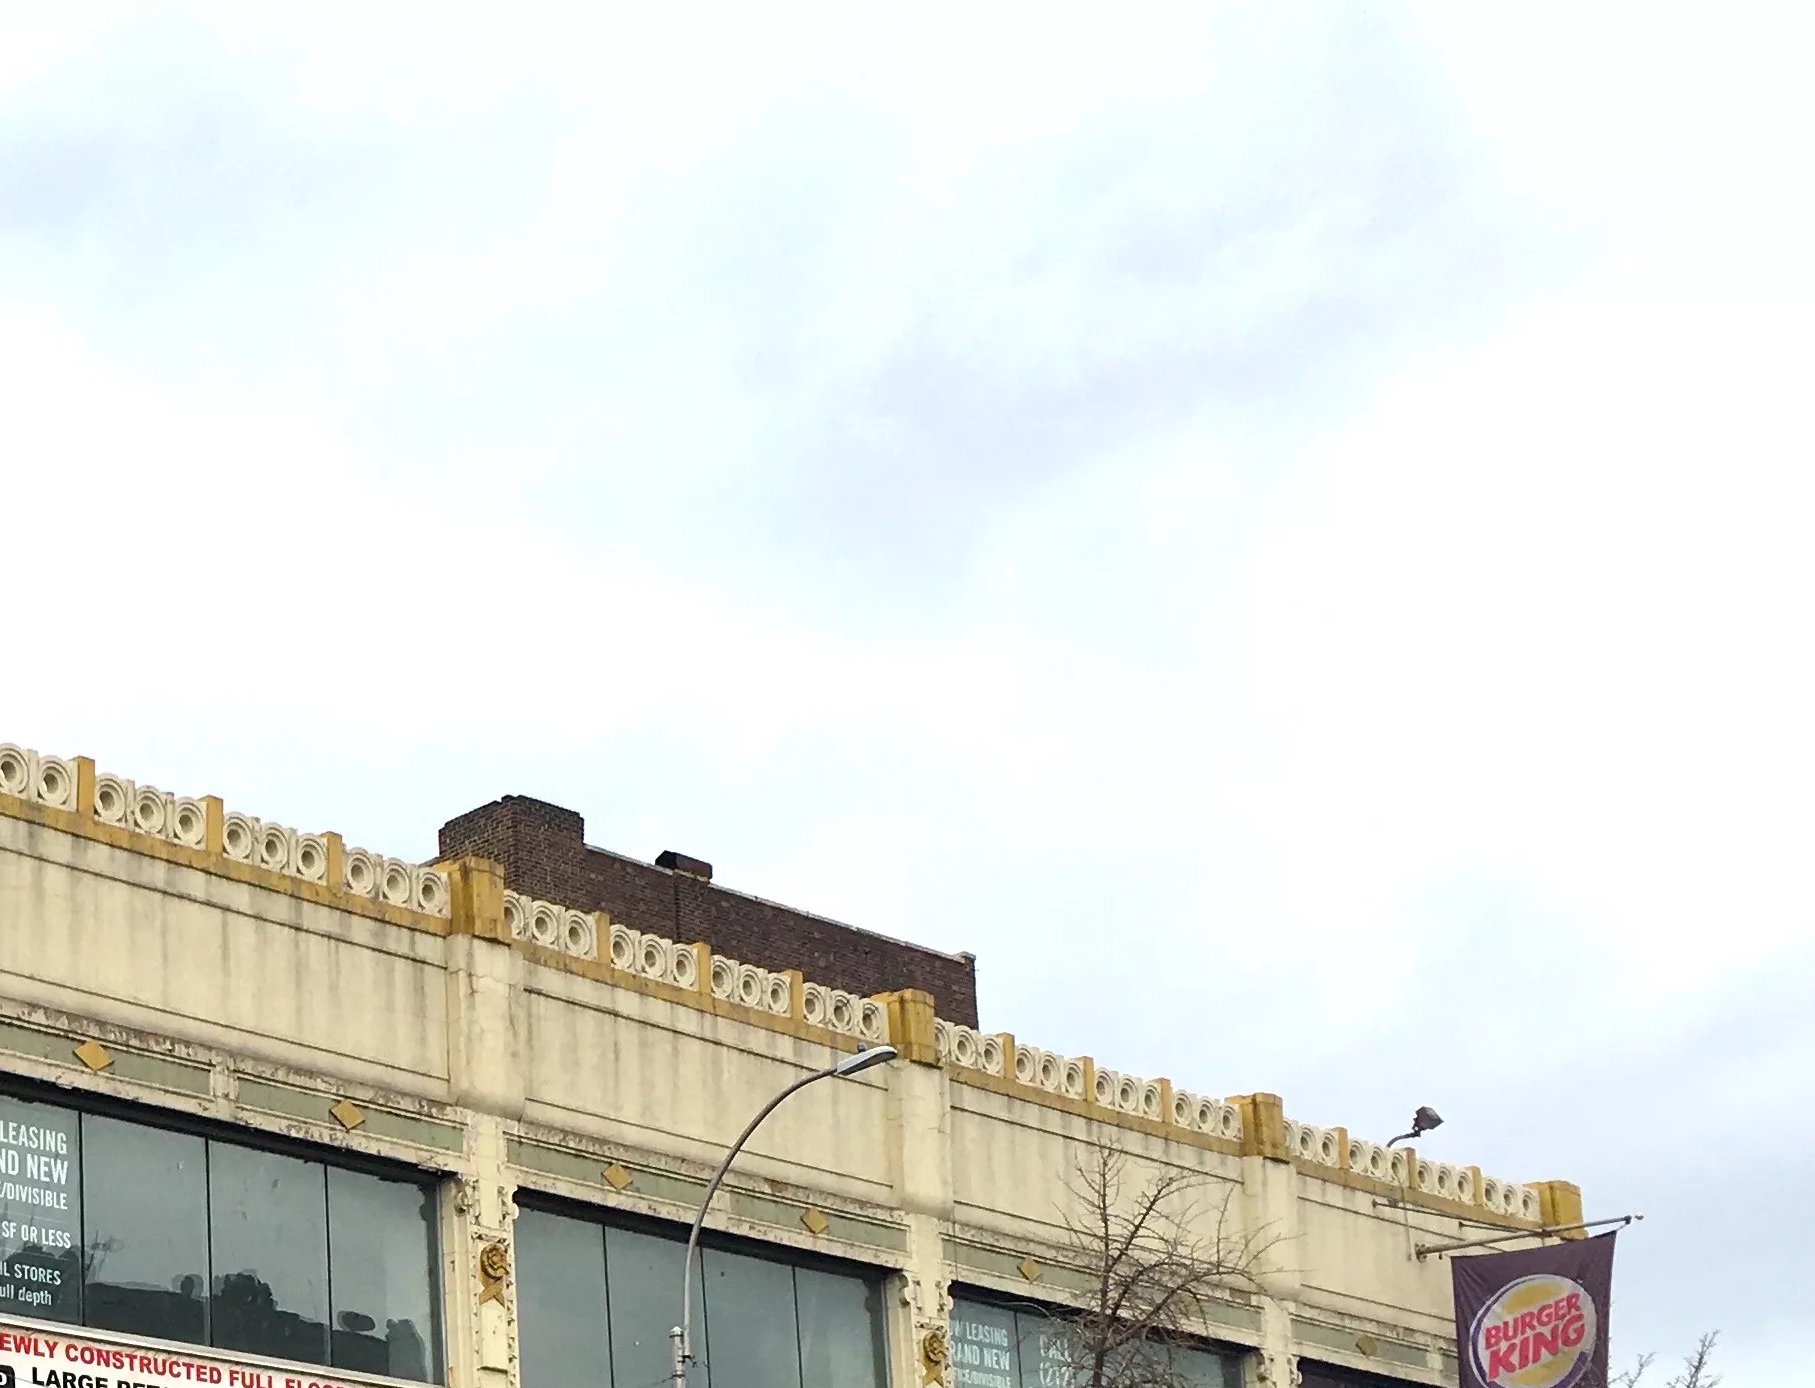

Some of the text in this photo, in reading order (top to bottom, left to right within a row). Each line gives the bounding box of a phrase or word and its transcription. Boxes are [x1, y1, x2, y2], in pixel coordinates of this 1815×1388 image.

[0, 1119, 68, 1155] LEASING
[26, 1152, 68, 1186] NEW
[1, 1220, 17, 1239] SF
[21, 1224, 38, 1243] OR
[41, 1228, 72, 1249] LESS
[14, 1263, 62, 1286] STORES
[18, 1286, 52, 1307] depth
[1485, 1293, 1582, 1350] BURGER
[65, 1343, 221, 1385] CONSTRUCTED
[983, 1347, 1010, 1371] NEW
[1488, 1313, 1586, 1382] KING
